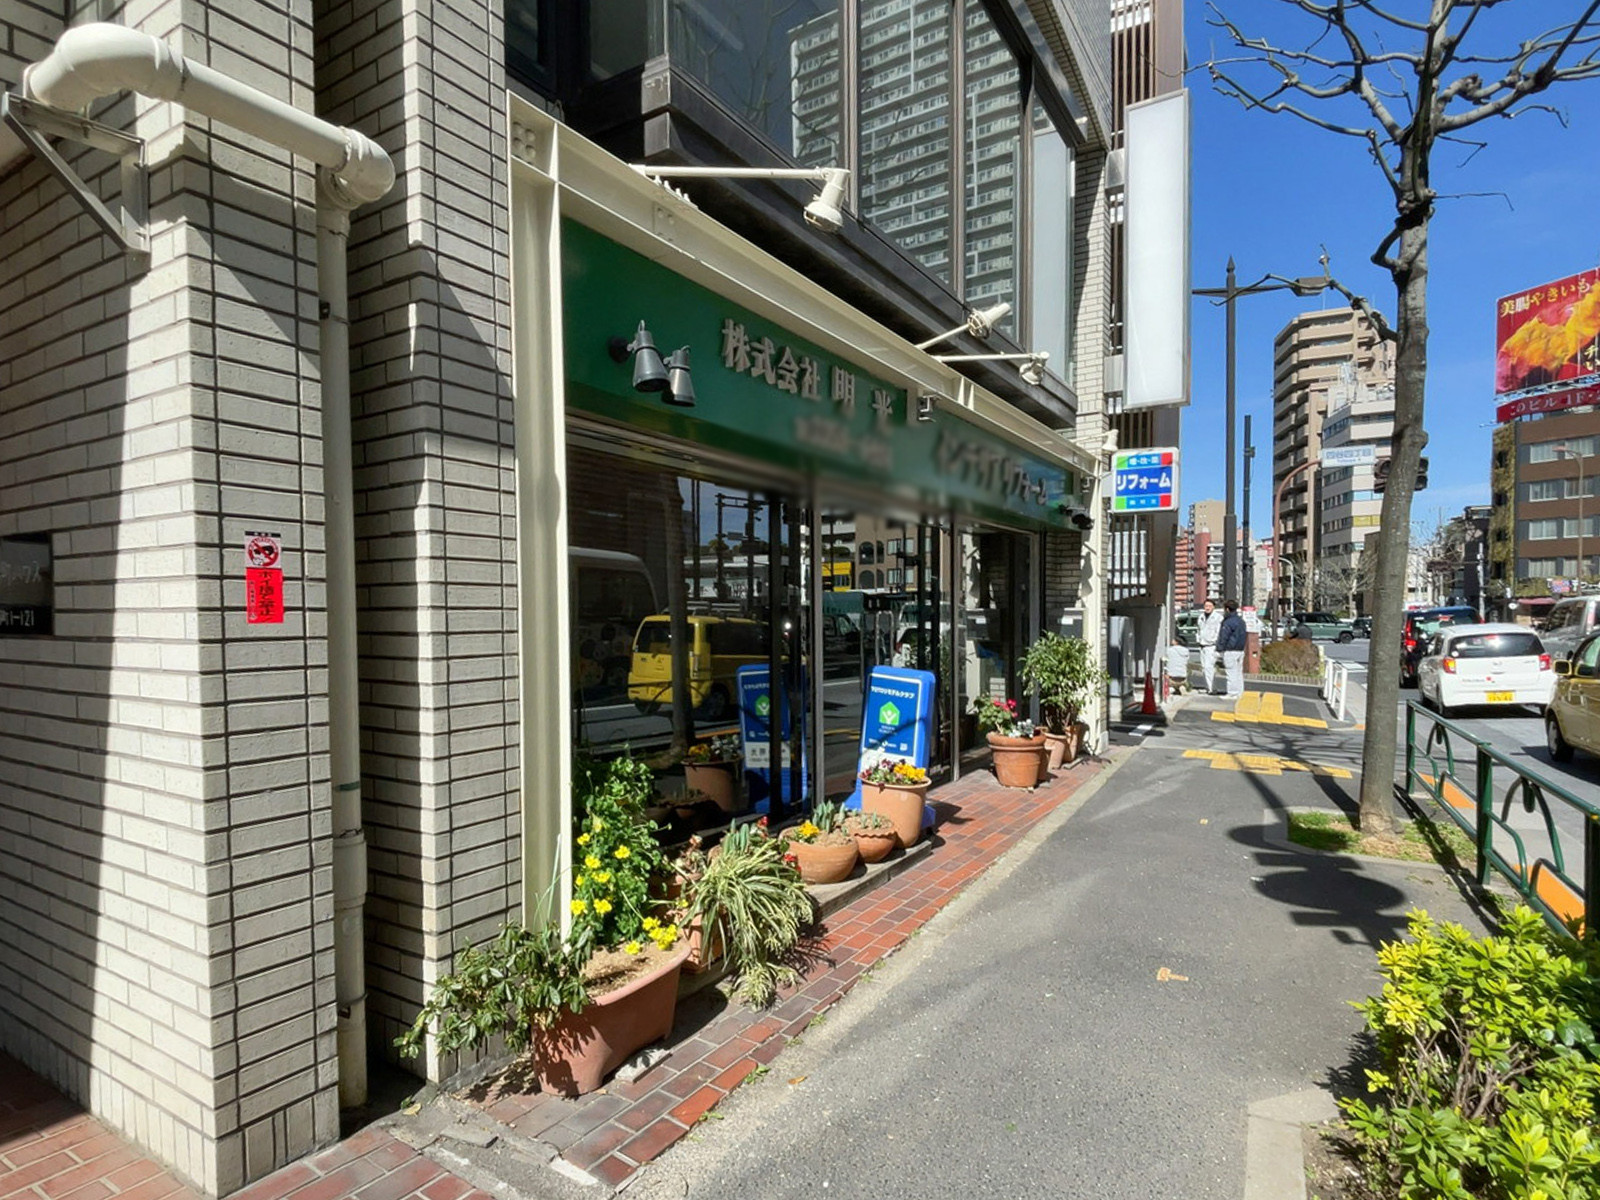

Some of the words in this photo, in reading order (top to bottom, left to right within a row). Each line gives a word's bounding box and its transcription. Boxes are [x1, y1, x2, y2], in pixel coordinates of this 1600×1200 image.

[721, 318, 820, 401] 株式会社
[1117, 472, 1171, 491] リフォーム
